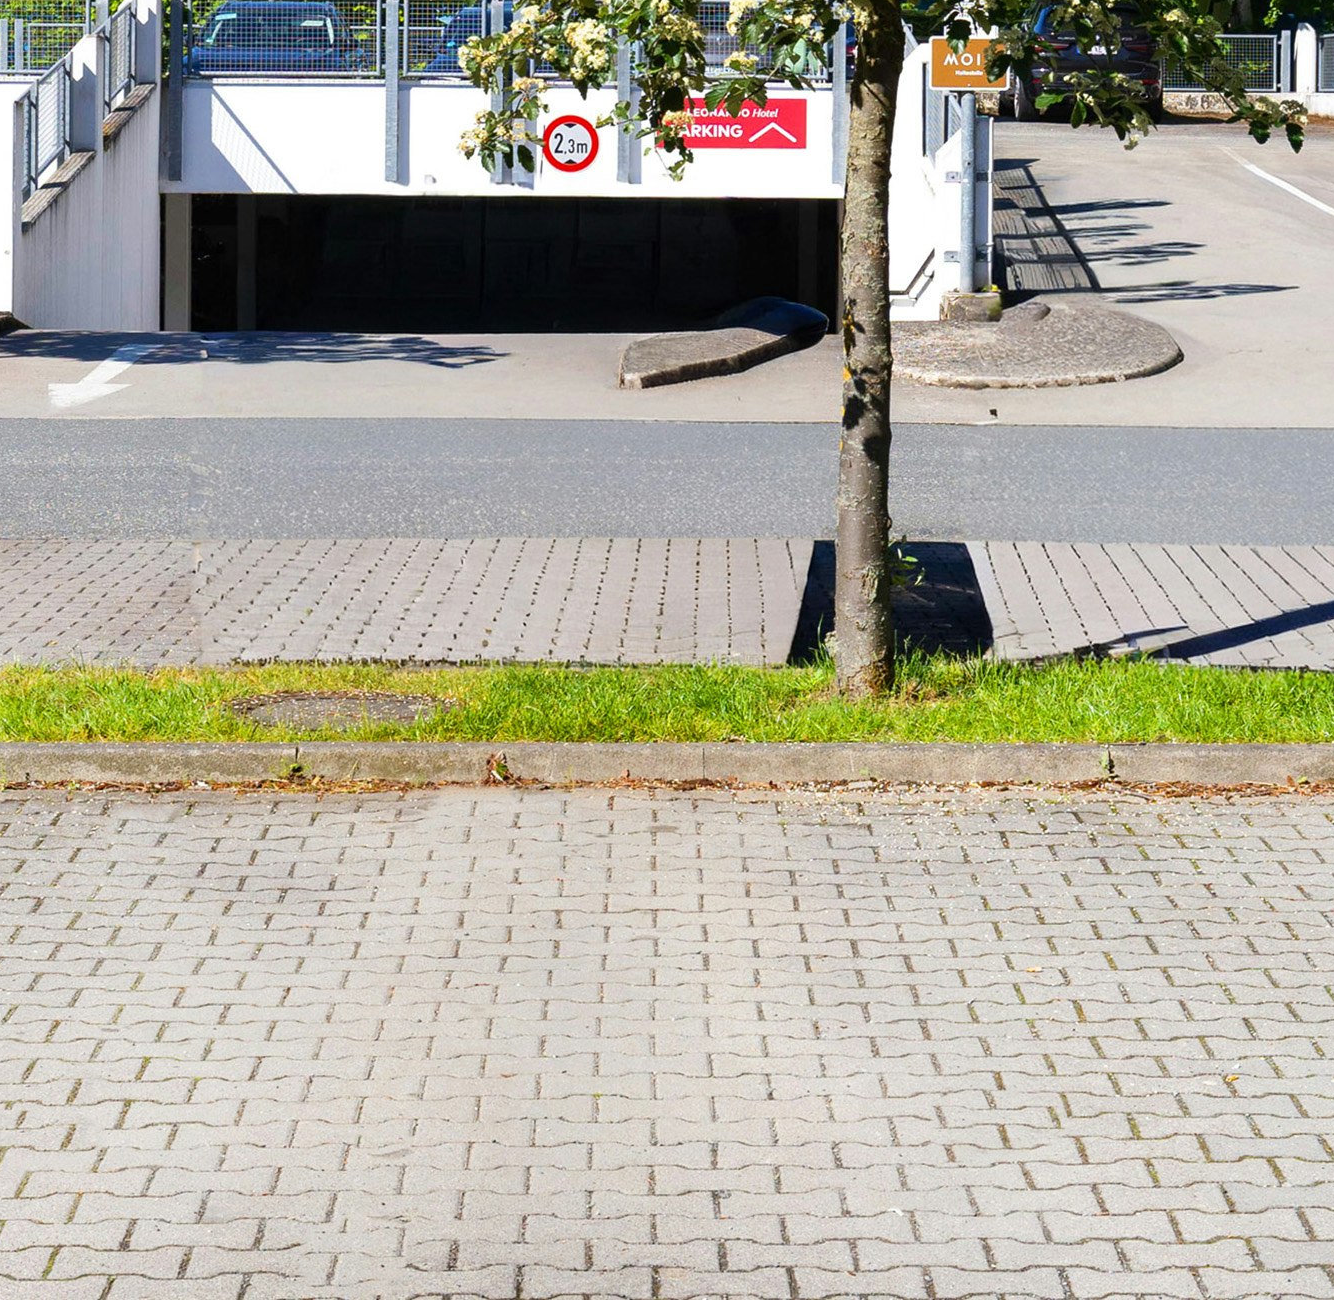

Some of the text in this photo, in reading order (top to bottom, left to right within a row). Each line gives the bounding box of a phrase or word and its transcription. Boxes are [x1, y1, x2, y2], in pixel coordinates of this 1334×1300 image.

[943, 52, 987, 66] MOI
[686, 107, 779, 118] LEONAO Hotel
[670, 124, 744, 138] ARKING
